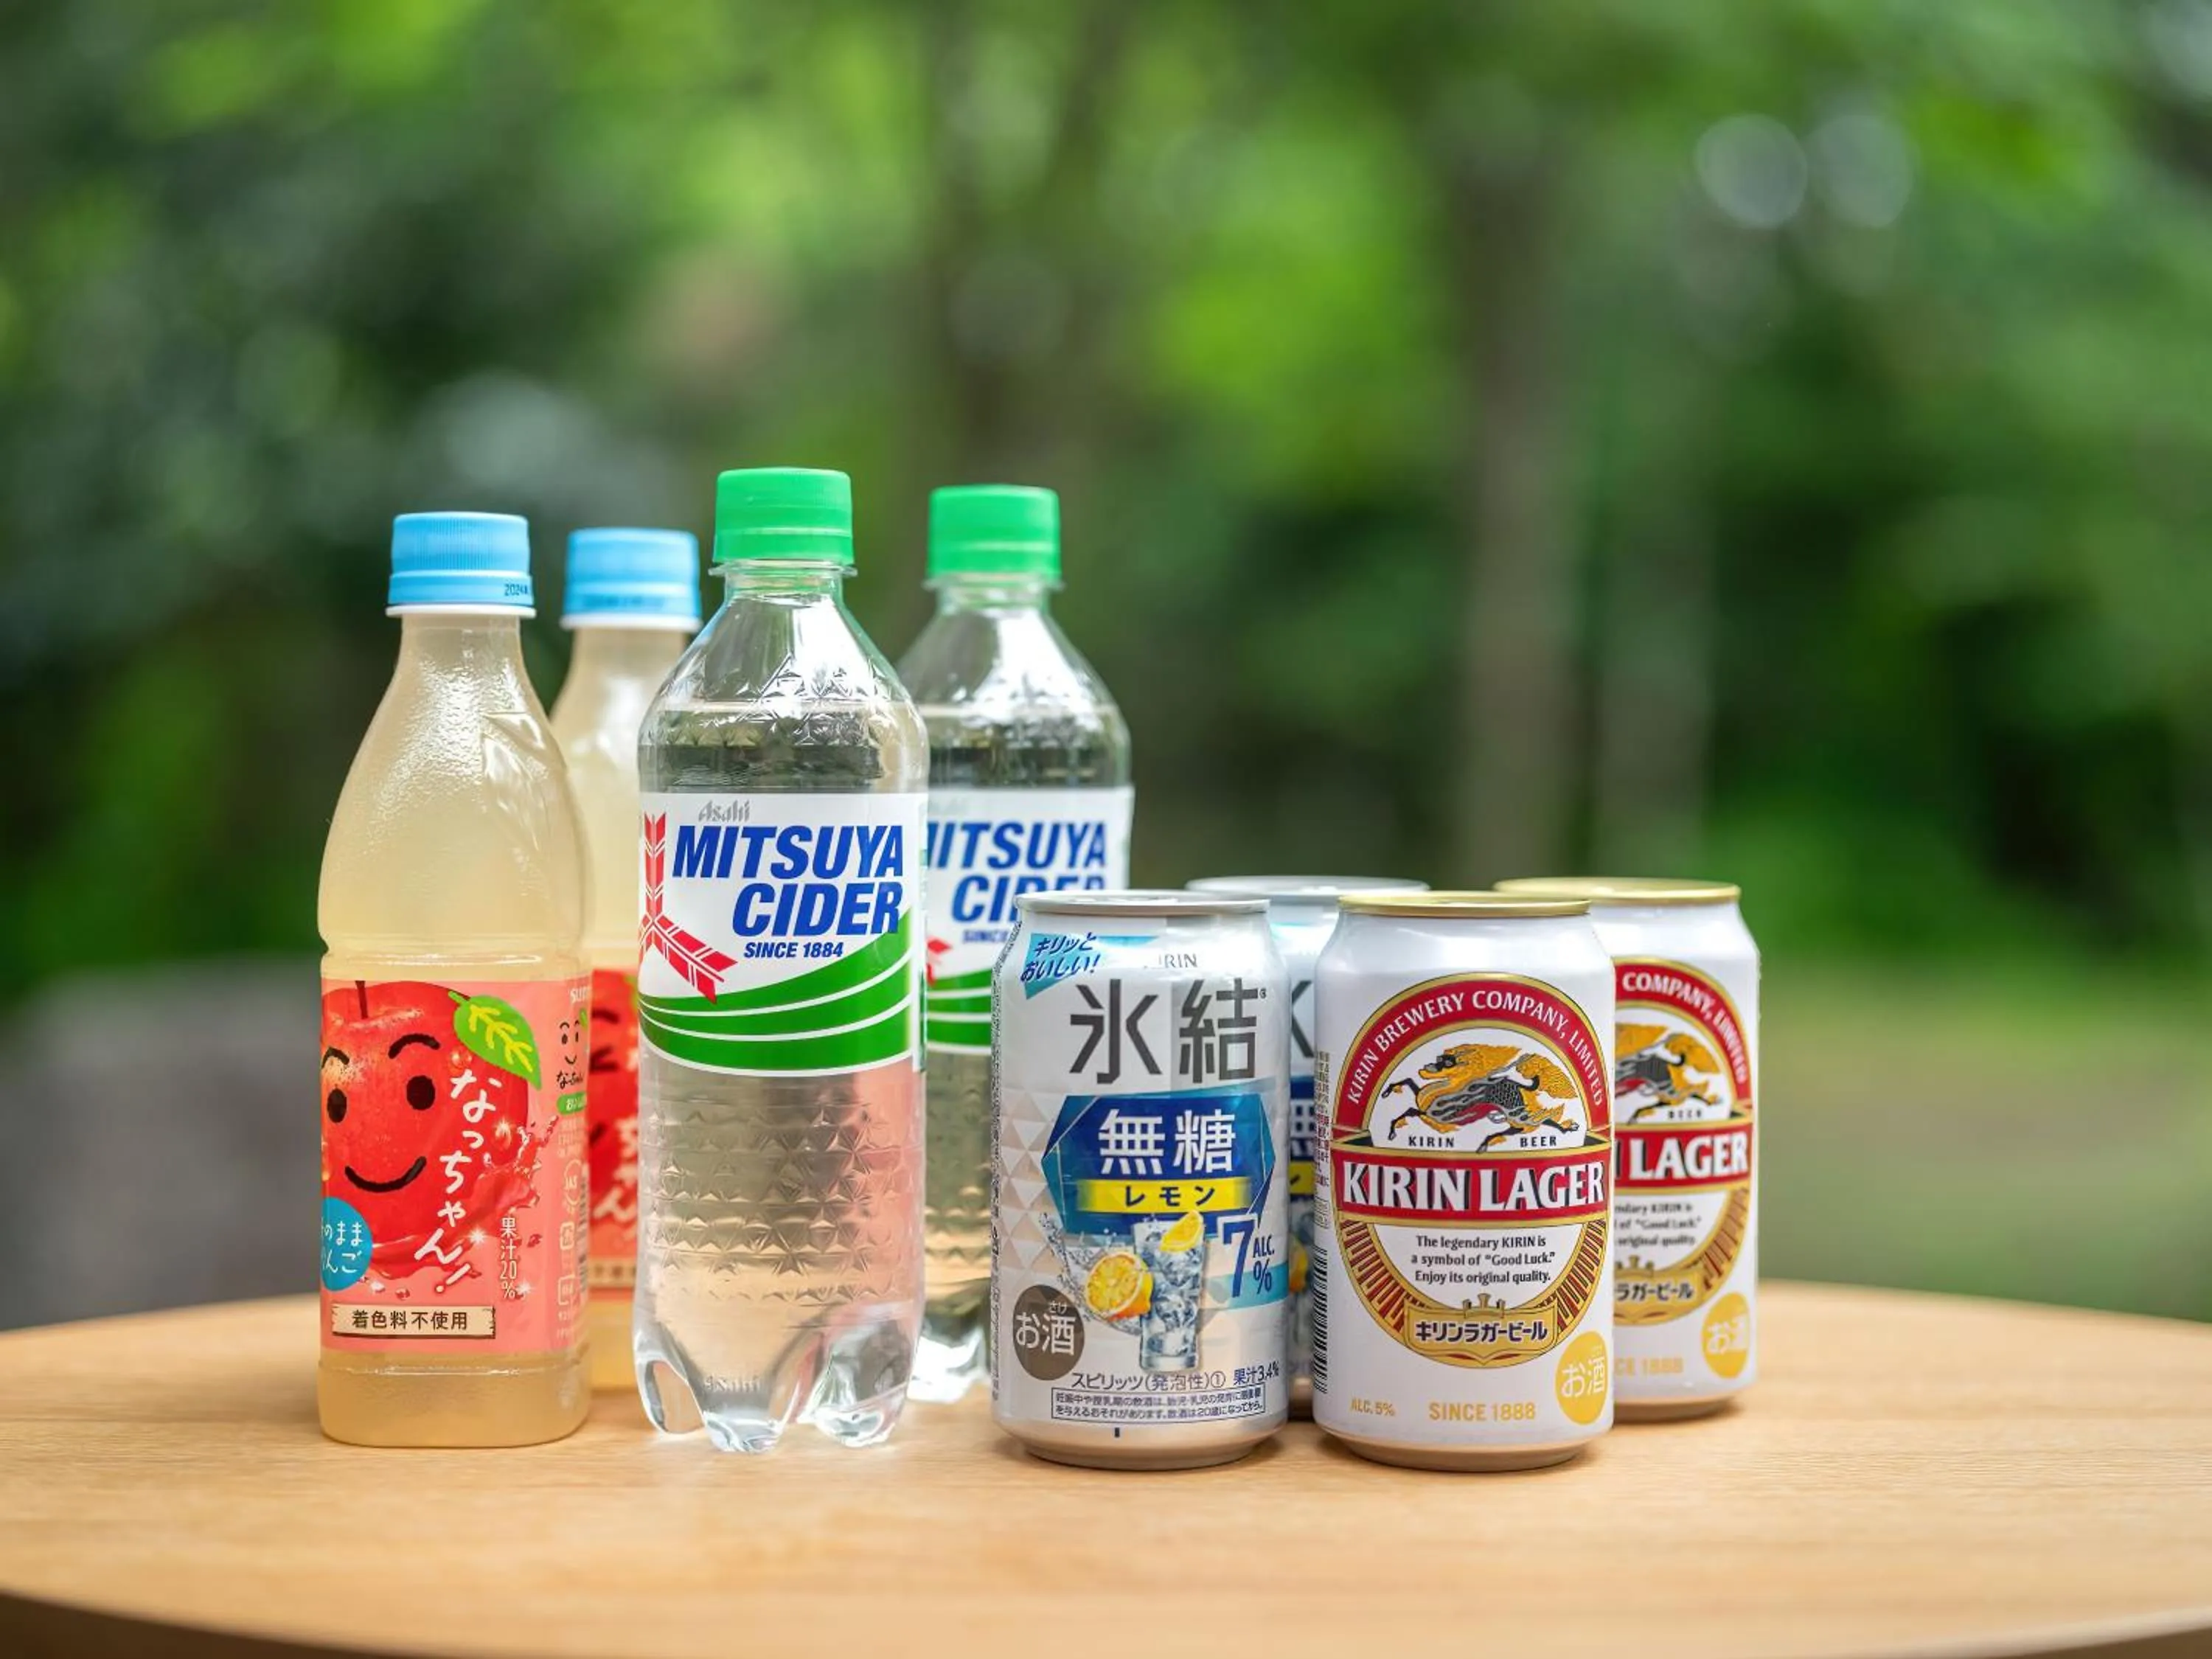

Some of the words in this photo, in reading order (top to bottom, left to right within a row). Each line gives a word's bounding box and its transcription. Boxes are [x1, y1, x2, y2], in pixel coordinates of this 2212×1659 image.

[698, 799, 750, 822] Asahi
[672, 824, 903, 880] MITSUYA
[732, 882, 903, 937] CIDER
[743, 942, 798, 959] SINCE
[803, 942, 844, 958] 1884
[1034, 932, 1096, 956] キリッと
[1020, 954, 1101, 981] おいしい!
[1152, 953, 1198, 969] IRIN
[1347, 1051, 1379, 1105] KIRIN
[1375, 992, 1465, 1052] BREWERY
[1472, 990, 1568, 1038] COMPANY,
[1568, 1030, 1605, 1106] LIMITED
[1098, 1109, 1237, 1174] 無糖
[1408, 1135, 1455, 1148] KIRIN
[1520, 1135, 1557, 1147] BEER
[1629, 1133, 1748, 1180] LAGER
[1126, 1186, 1215, 1207] レモン
[1343, 1161, 1471, 1211] KIRIN
[1479, 1161, 1606, 1211] LAGER
[321, 1220, 363, 1247] のまま
[1416, 1235, 1438, 1248] The
[1440, 1236, 1499, 1251] legendary
[1502, 1236, 1535, 1248] KIRIN
[1537, 1235, 1546, 1247] is
[1222, 1219, 1255, 1298] 7
[1253, 1234, 1275, 1258] ALC.
[1411, 1254, 1418, 1264] a
[1421, 1253, 1465, 1267] symbol
[1468, 1253, 1481, 1266] of
[1415, 1270, 1447, 1284] Enjoy
[1449, 1270, 1464, 1283] its
[1466, 1270, 1509, 1285] original
[1512, 1270, 1551, 1284] quality.
[351, 1310, 467, 1330] 着色料不使用
[1015, 1312, 1076, 1355] お酒
[1416, 1321, 1548, 1343] キリンラガービール
[1561, 1357, 1605, 1397] お酒
[1351, 1398, 1374, 1413] ALC.
[1375, 1403, 1396, 1416] 5%
[1429, 1402, 1486, 1421] SINCE
[1492, 1402, 1537, 1421] 1888
